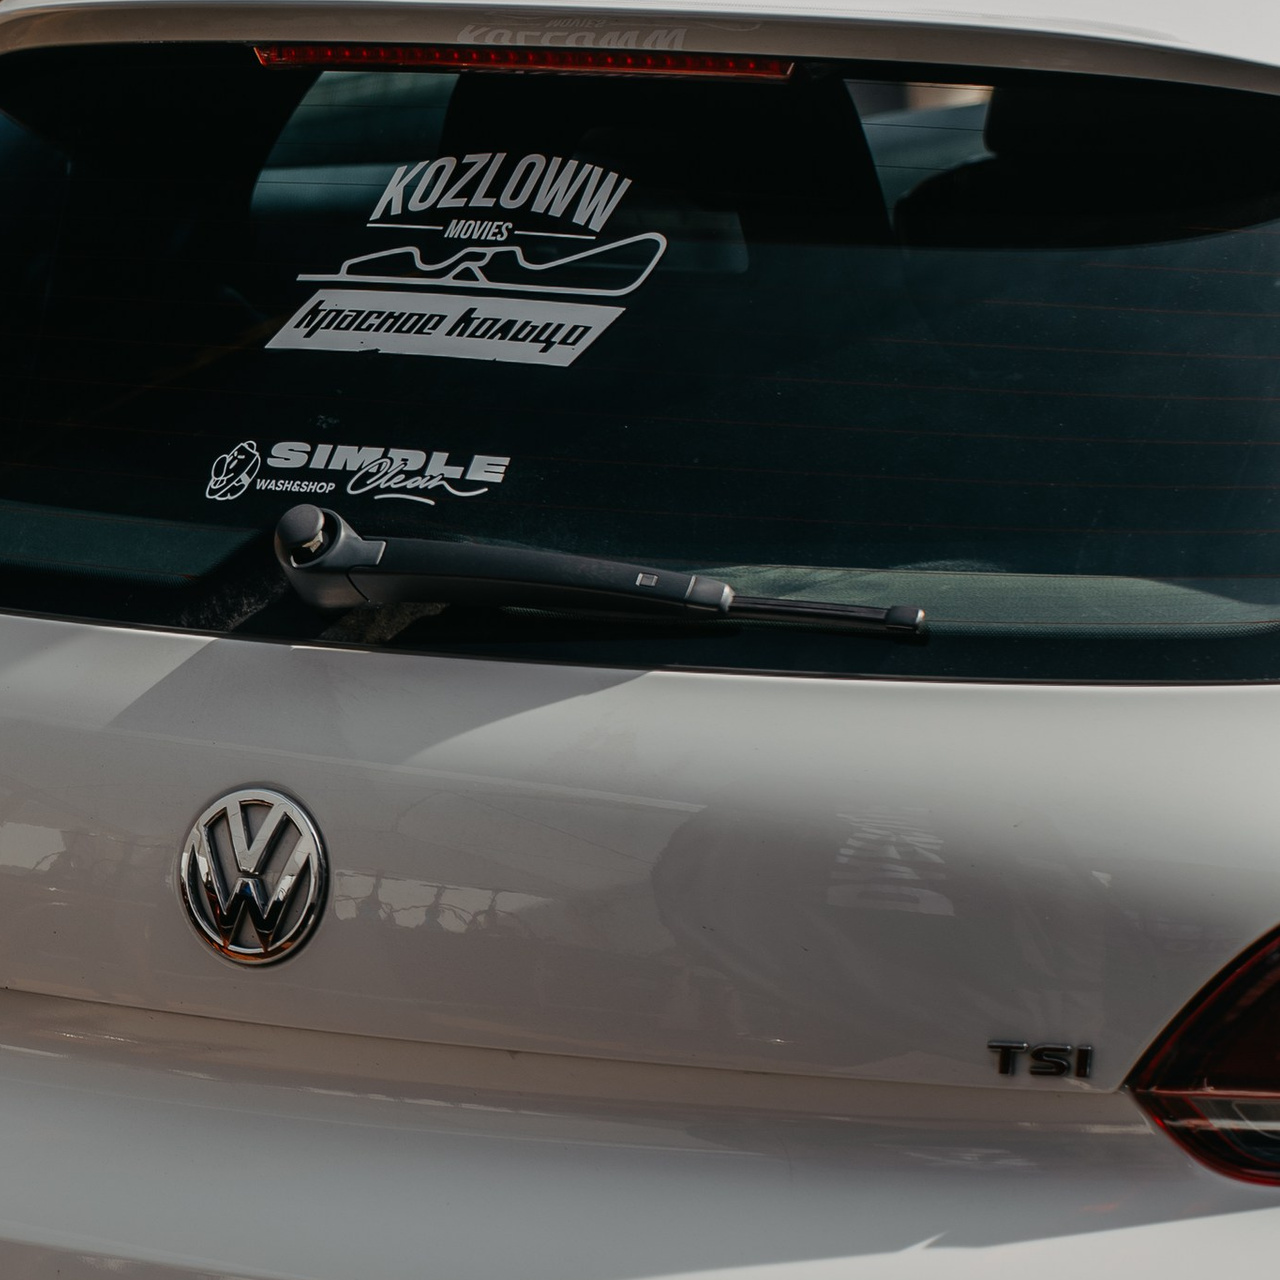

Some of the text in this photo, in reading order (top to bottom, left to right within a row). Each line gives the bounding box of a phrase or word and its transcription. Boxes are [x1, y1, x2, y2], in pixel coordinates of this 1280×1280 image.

[369, 152, 633, 233] KOZLOWW
[444, 219, 513, 241] MOVIES
[267, 441, 511, 483] SIMPLE
[346, 457, 489, 497] Clean
[255, 478, 336, 494] WASH&SHOP
[987, 1040, 1094, 1078] TSI
